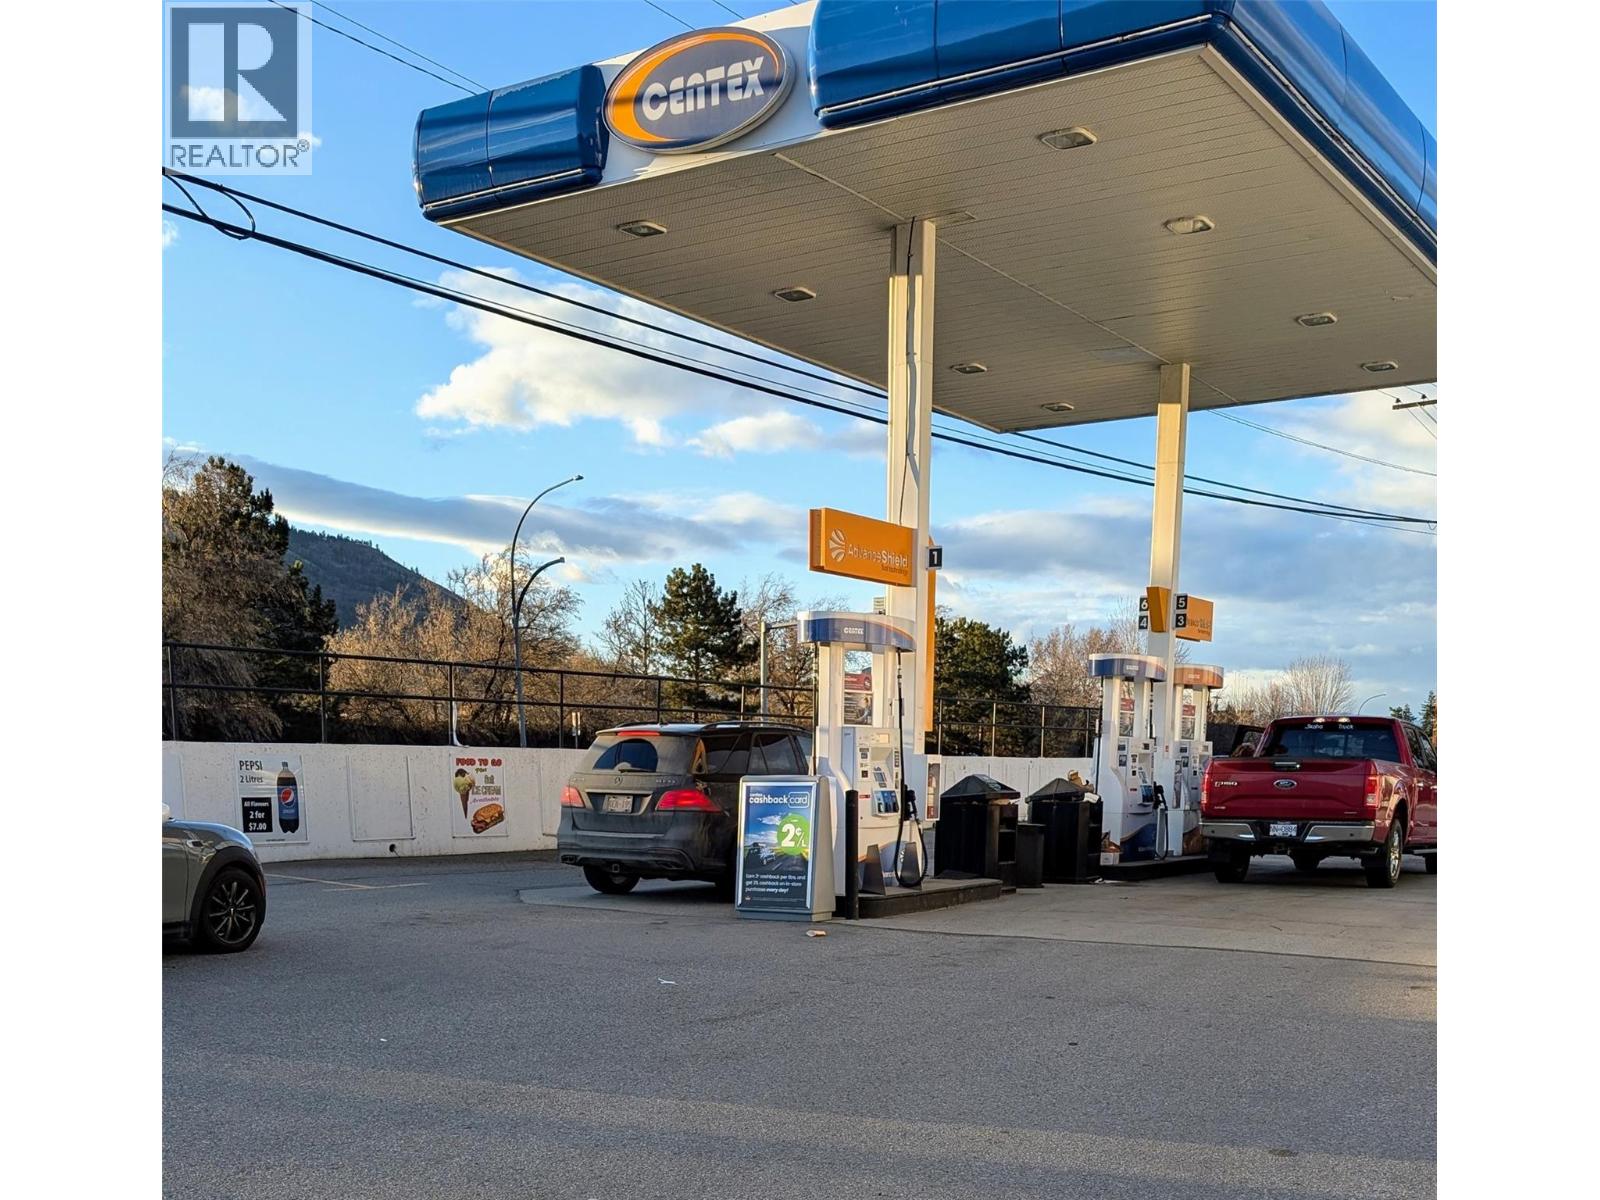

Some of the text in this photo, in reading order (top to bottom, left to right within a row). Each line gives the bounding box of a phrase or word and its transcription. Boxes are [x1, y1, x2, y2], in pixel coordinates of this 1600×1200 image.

[642, 56, 764, 121] CENTEX
[932, 551, 938, 565] 1
[1141, 600, 1148, 609] 6
[1178, 597, 1185, 608] 5
[1140, 618, 1147, 628] 4
[1177, 615, 1185, 626] 3
[239, 760, 263, 771] PEPSI
[456, 758, 502, 767] FOOD TO GO
[246, 775, 263, 783] Litres
[749, 795, 808, 804] cashback card
[255, 811, 265, 819] for
[249, 822, 267, 831] $7.00
